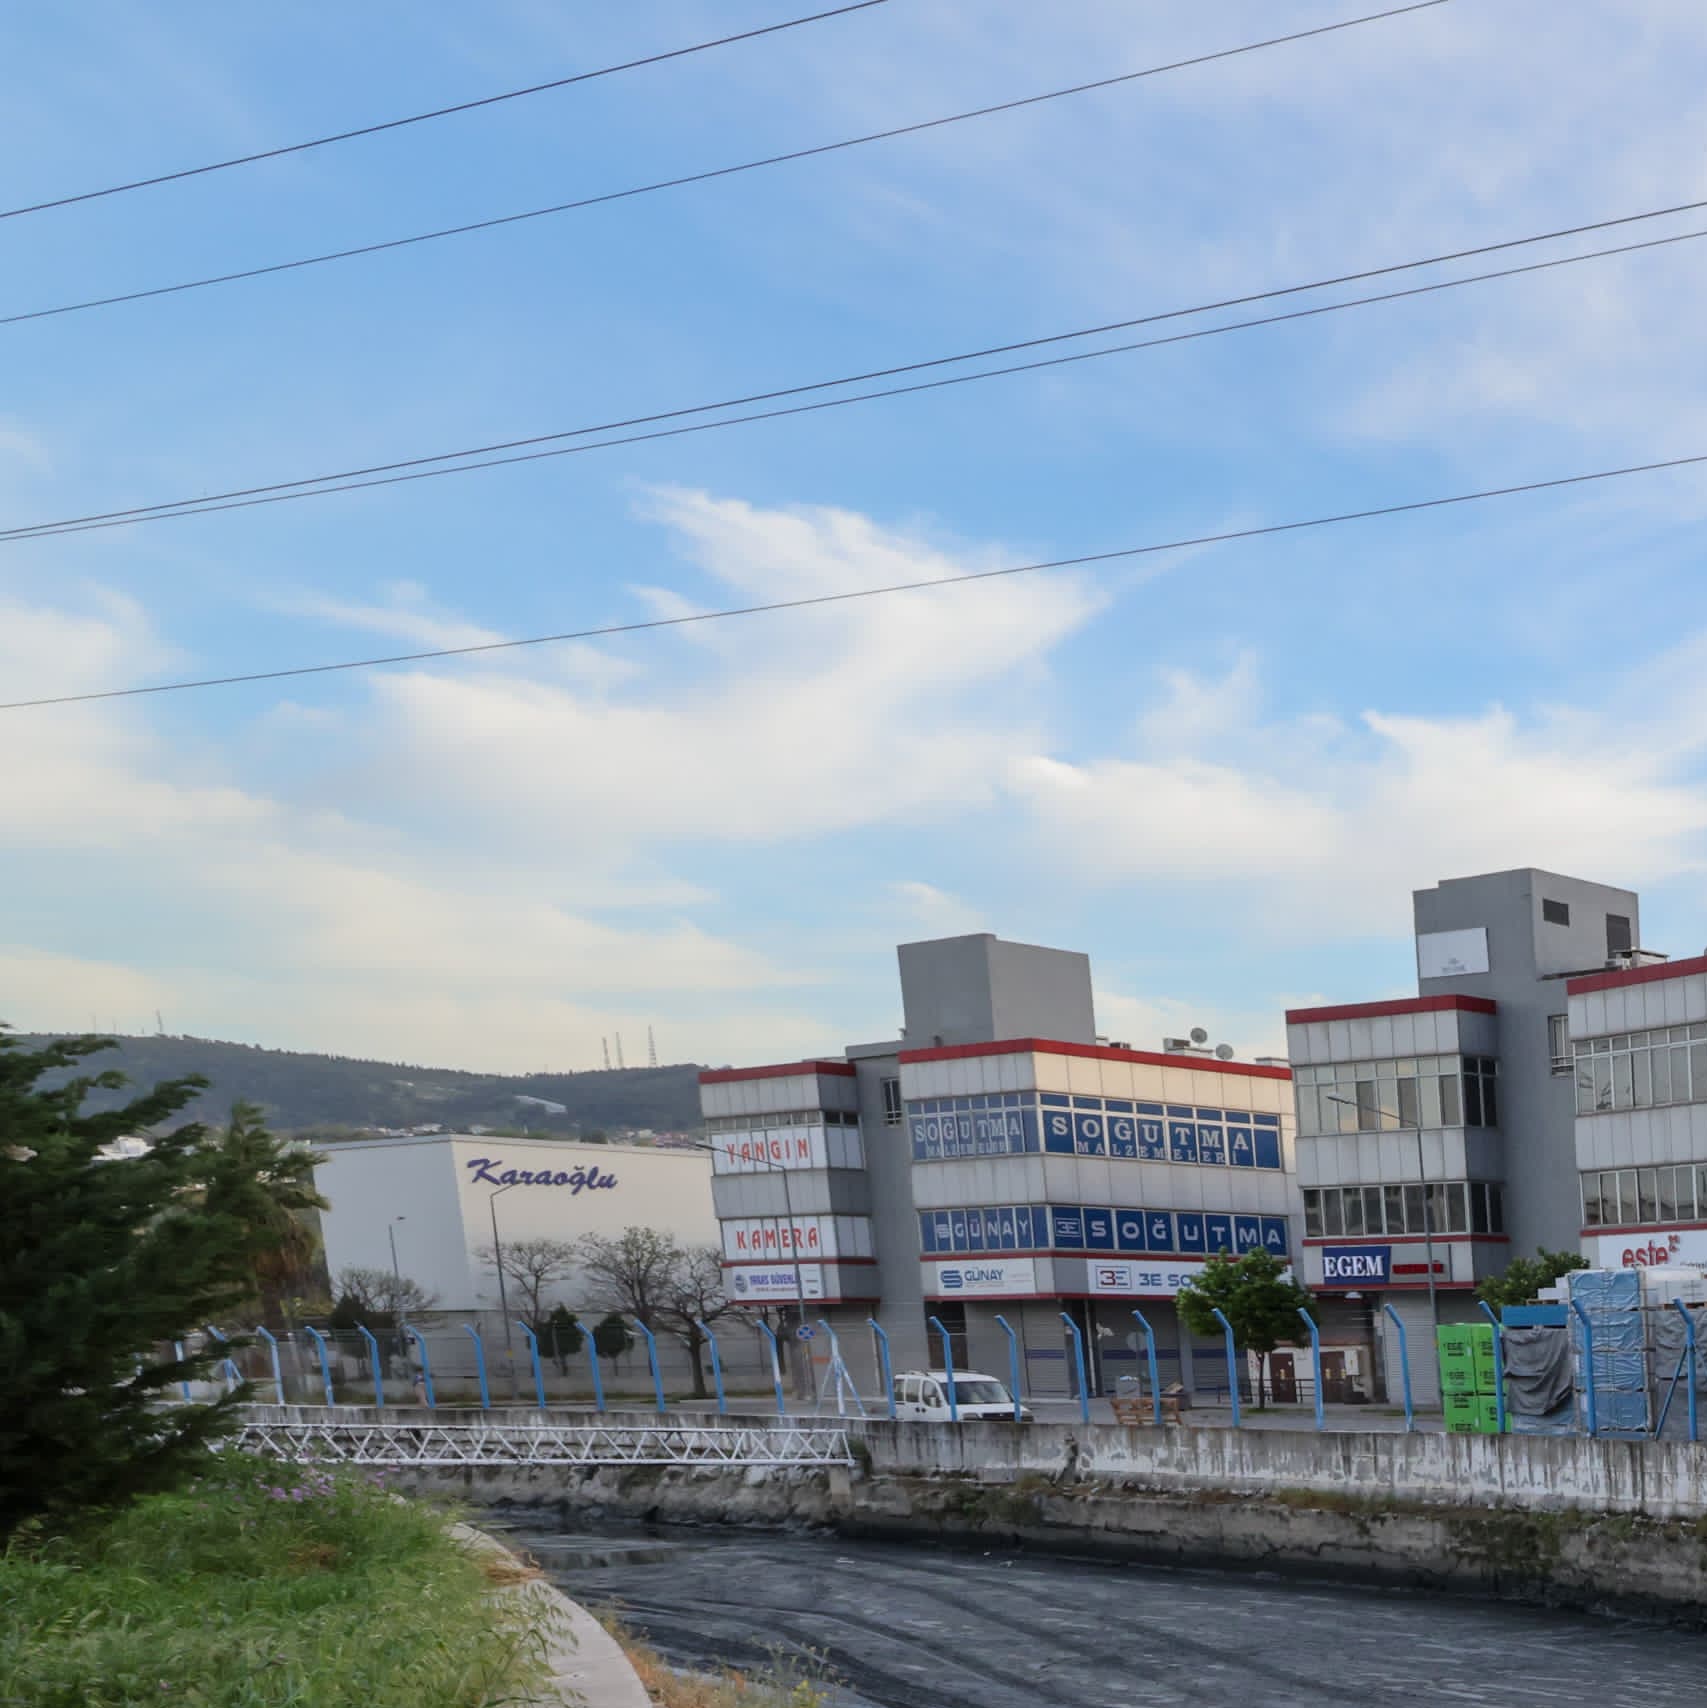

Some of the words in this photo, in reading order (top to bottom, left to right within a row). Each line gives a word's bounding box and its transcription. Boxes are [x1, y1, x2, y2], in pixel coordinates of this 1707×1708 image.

[914, 1116, 1021, 1143] SOĞUTMA
[1051, 1115, 1250, 1151] SOĞUTMA
[726, 1137, 809, 1166] YANGIN
[1077, 1140, 1238, 1164] MALZEMELERİ
[467, 1158, 619, 1196] Karaoğlu
[736, 1227, 819, 1250] KAMERA
[954, 1218, 1028, 1238] GÜNAY
[1090, 1218, 1282, 1246] SOĞUTMA
[964, 1266, 1004, 1281] GÜNAY
[1324, 1255, 1385, 1278] EGEM
